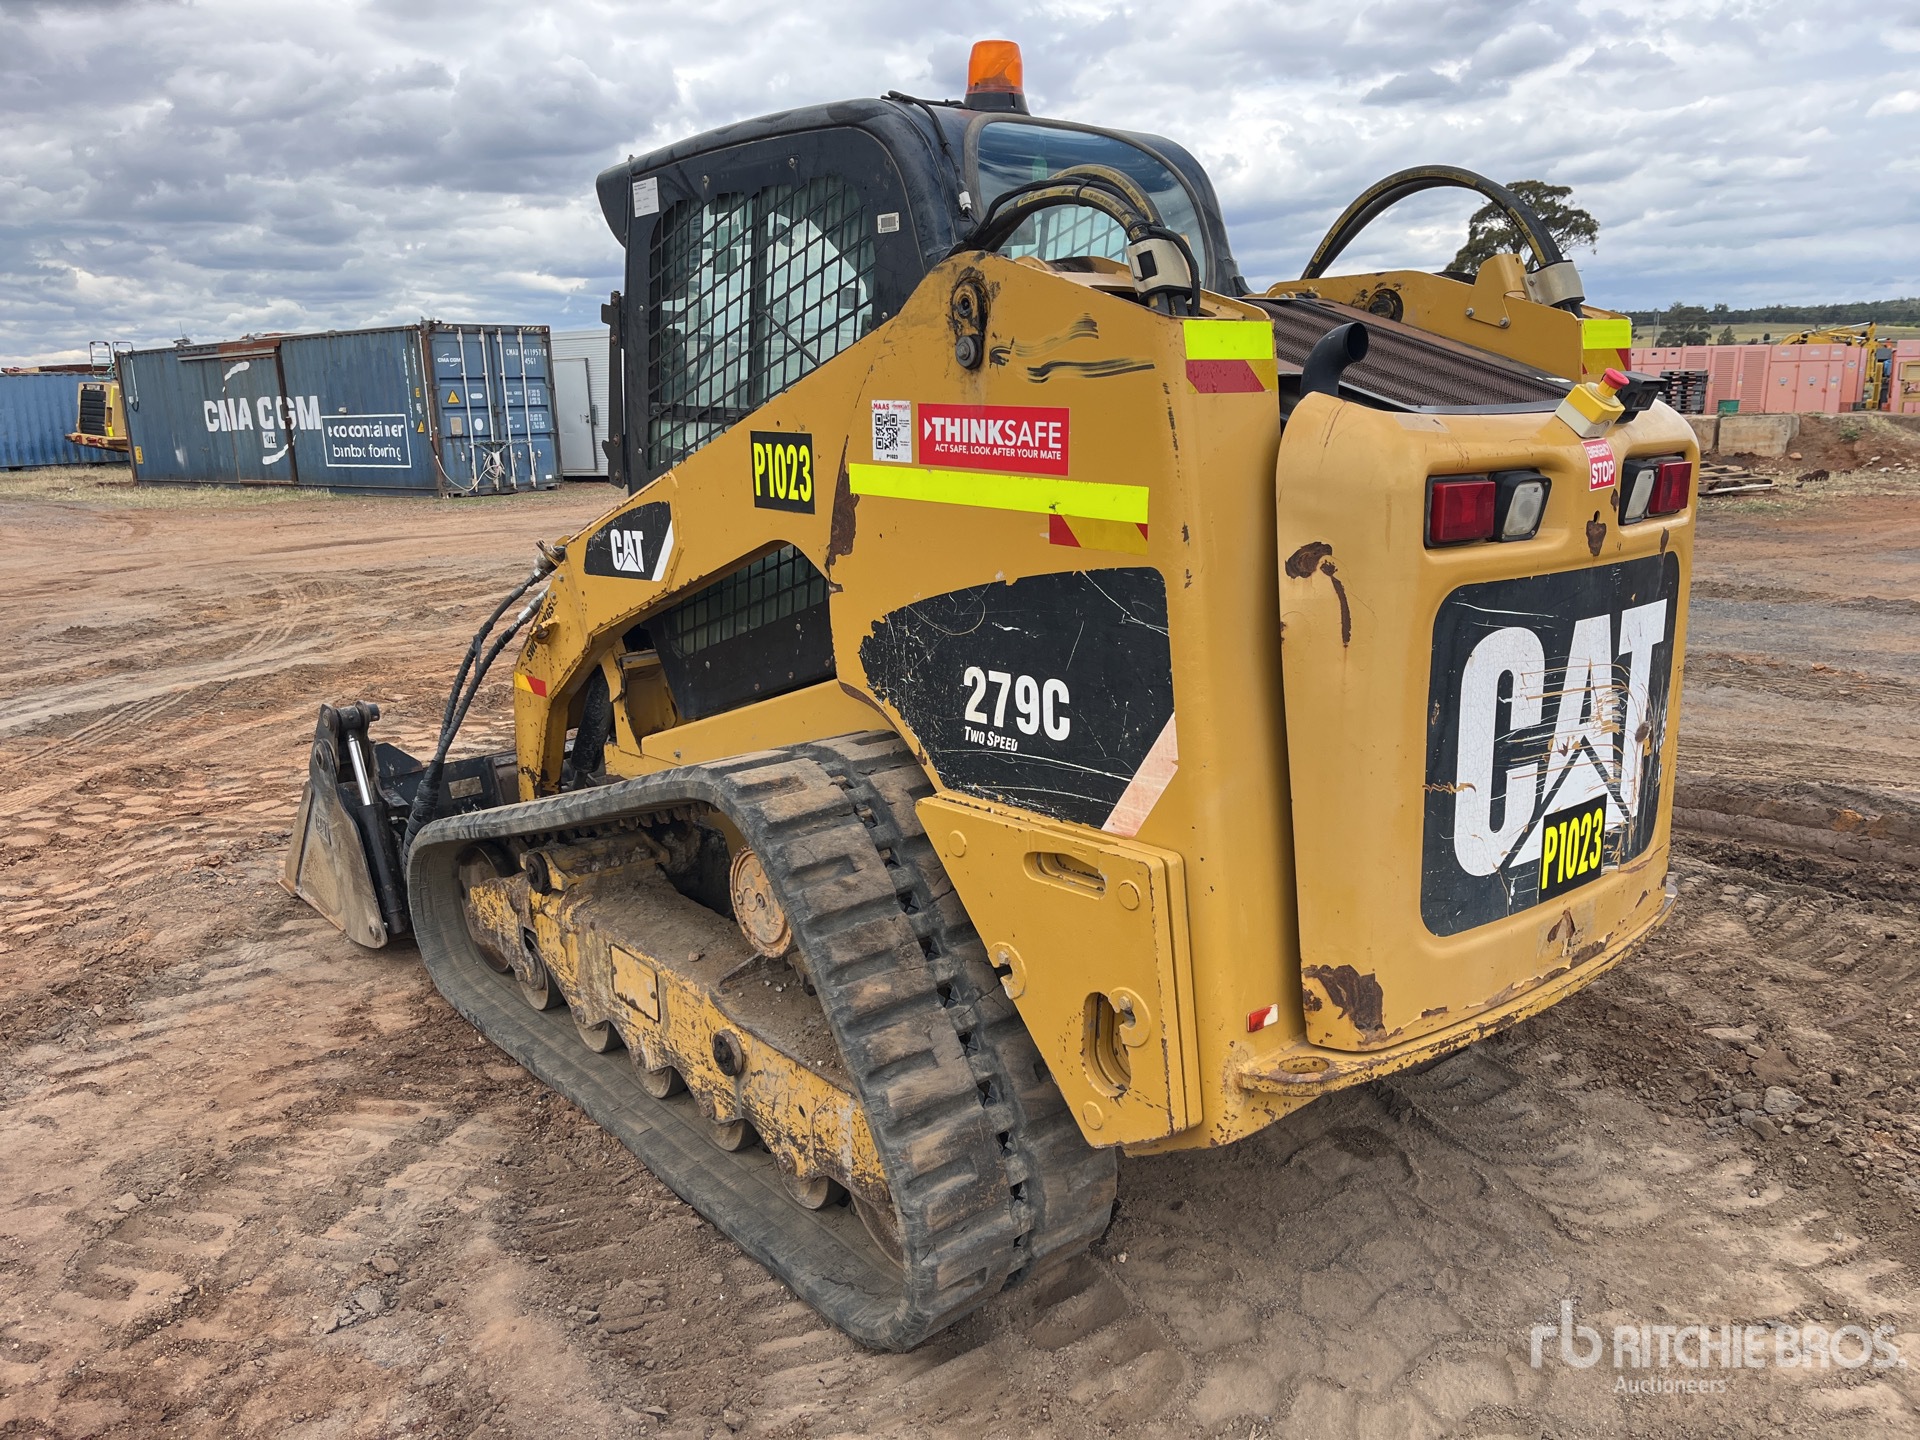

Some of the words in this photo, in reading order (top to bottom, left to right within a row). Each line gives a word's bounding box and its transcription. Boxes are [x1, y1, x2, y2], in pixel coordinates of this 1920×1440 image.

[204, 398, 254, 432] CMA
[256, 396, 322, 430] CGM
[931, 416, 1062, 448] THINKSAFE
[754, 442, 812, 502] P1023
[934, 444, 948, 452] ACT
[950, 445, 969, 454] SAFE,
[970, 446, 991, 456] LOOK
[992, 448, 1016, 457] AFTER
[1017, 449, 1038, 459] YOUR
[1040, 451, 1062, 460] MATE
[1592, 460, 1614, 484] STOP
[610, 529, 644, 572] CAT
[964, 666, 1070, 741] 279C
[1454, 598, 1667, 877] CAT
[1541, 808, 1604, 890] P1023
